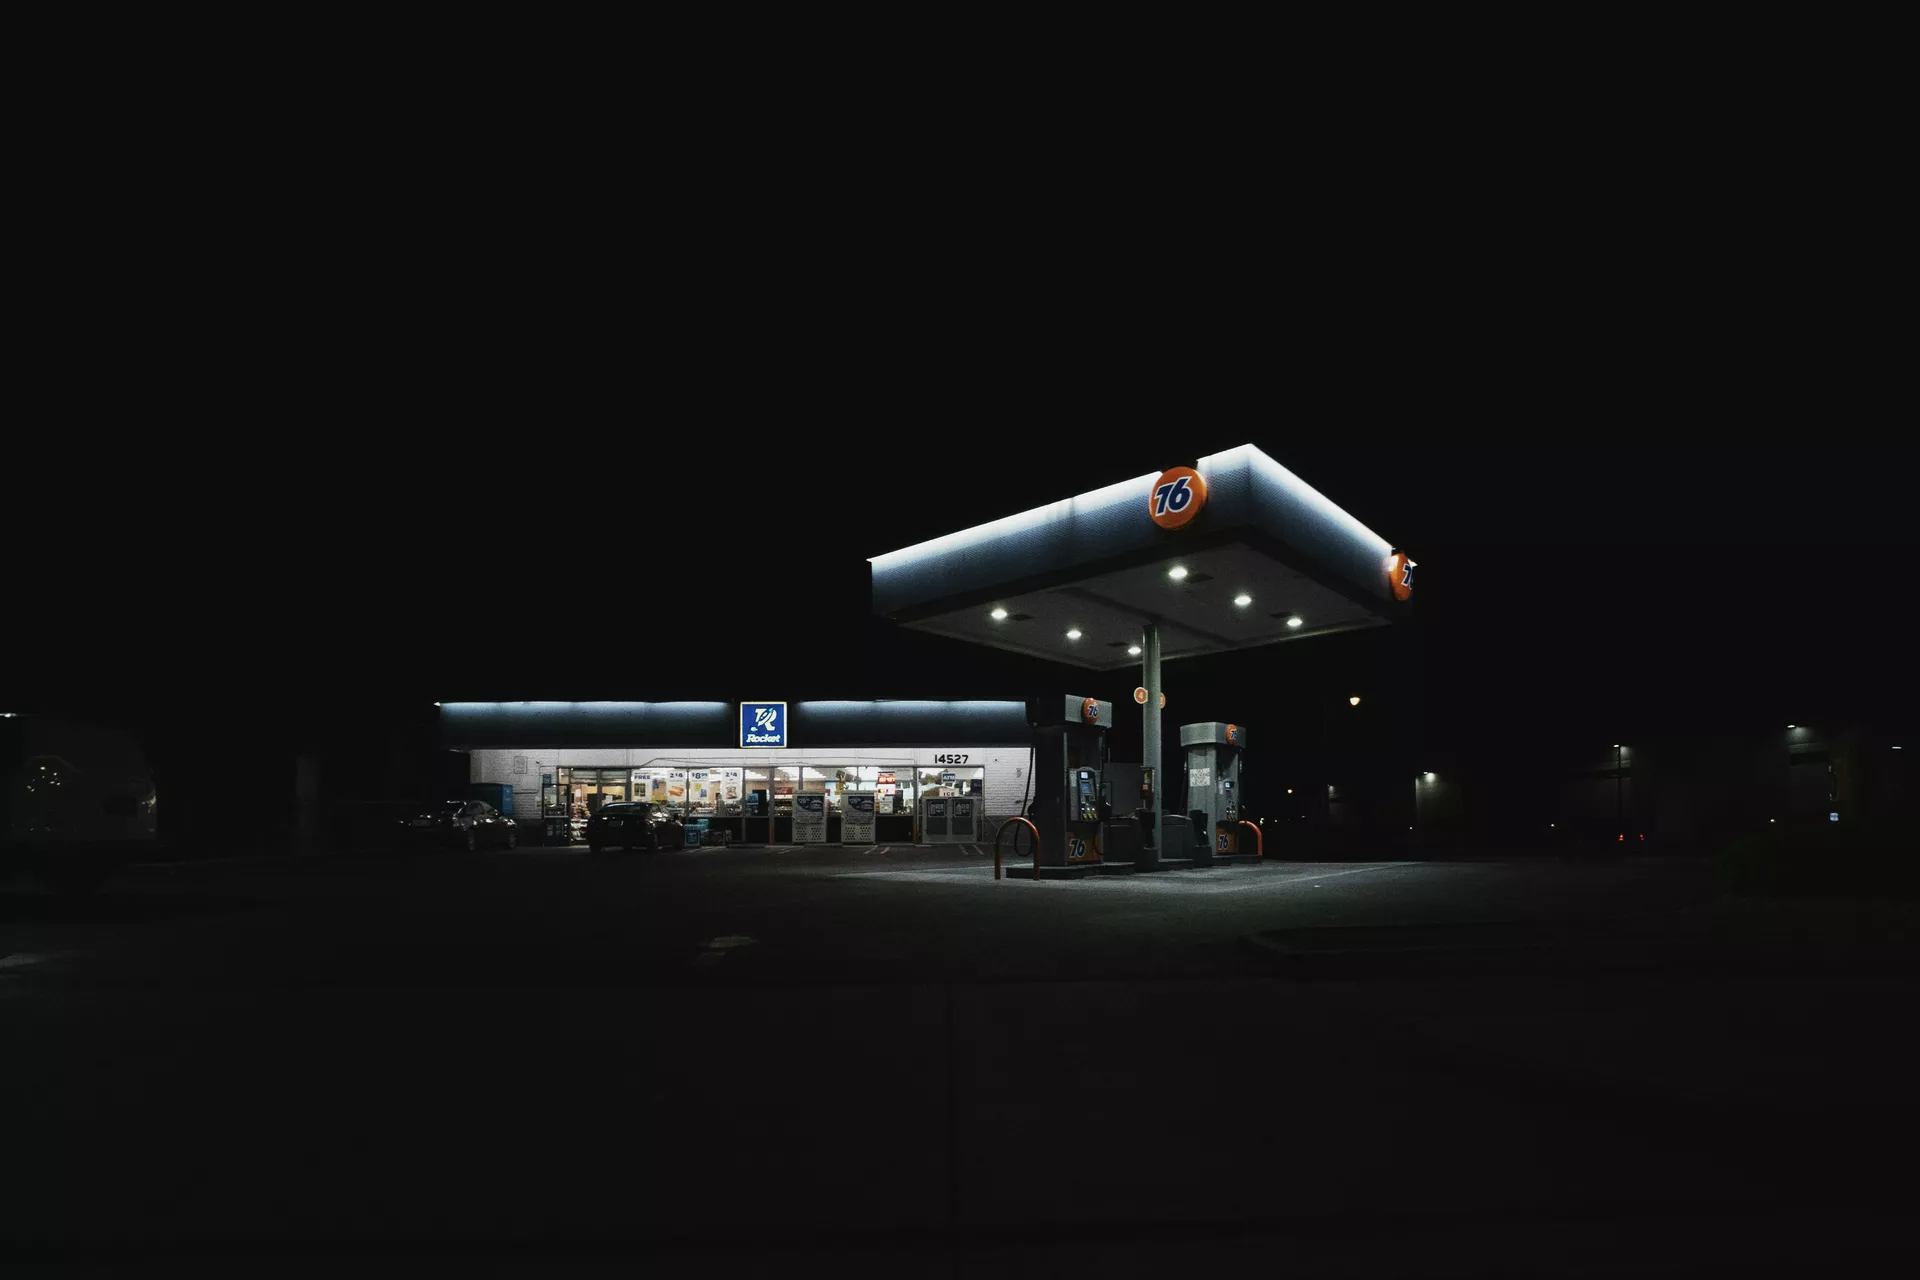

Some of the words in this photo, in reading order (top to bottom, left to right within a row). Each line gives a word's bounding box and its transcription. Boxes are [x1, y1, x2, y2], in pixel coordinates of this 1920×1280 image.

[1154, 476, 1193, 517] 76
[746, 734, 781, 743] Rocket
[934, 754, 969, 764] 14527
[1069, 838, 1086, 858] 76
[1219, 834, 1229, 850] 76
